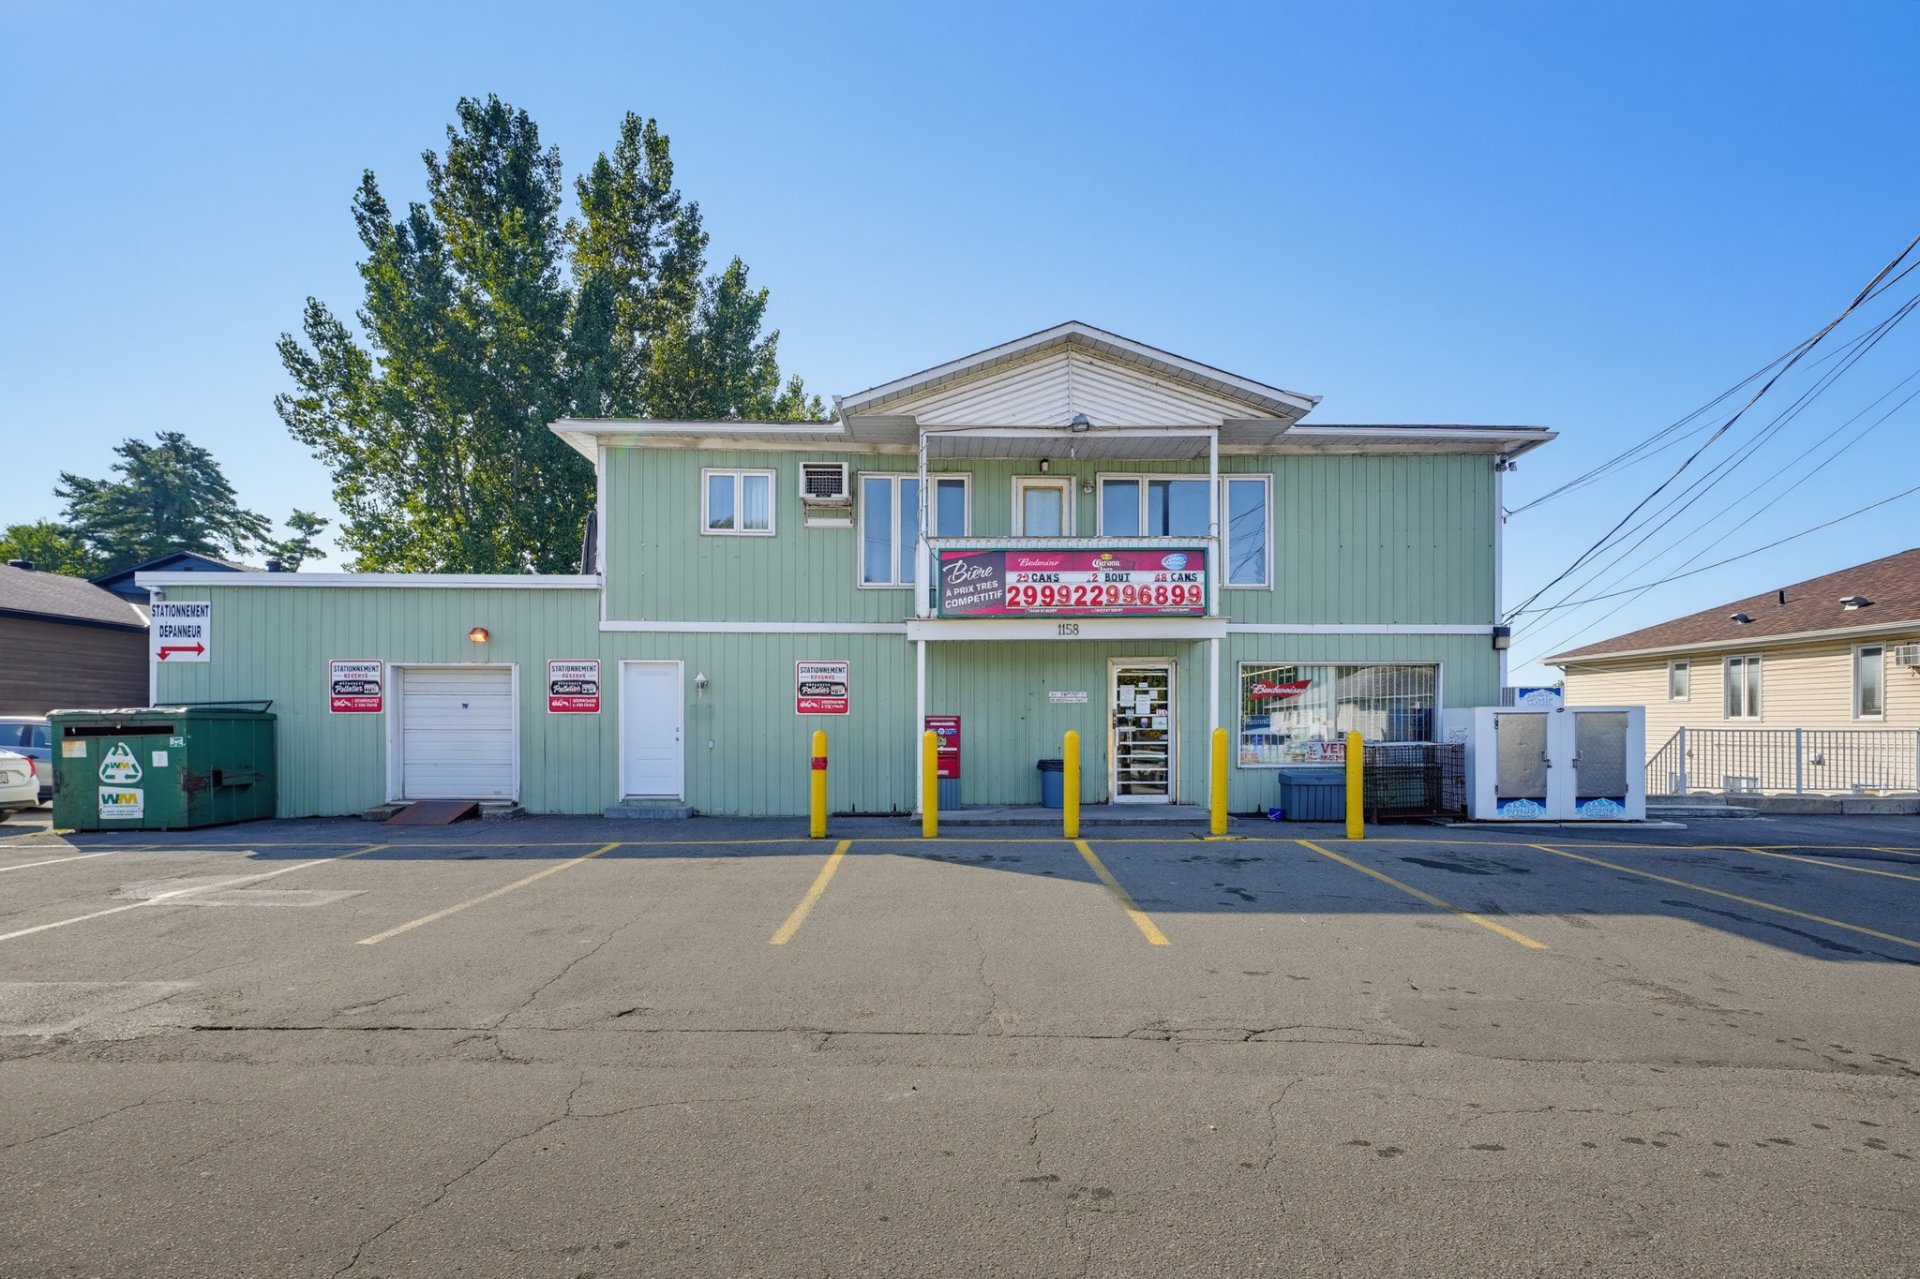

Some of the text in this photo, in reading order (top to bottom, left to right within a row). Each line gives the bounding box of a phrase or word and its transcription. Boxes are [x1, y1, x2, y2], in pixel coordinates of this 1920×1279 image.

[1018, 558, 1059, 567] Budweiser
[1092, 559, 1120, 568] Corona
[943, 560, 993, 584] Bière
[1031, 573, 1060, 582] CANS
[1092, 573, 1130, 582] 2 BOUT
[1171, 573, 1198, 582] CANS
[954, 585, 974, 595] PRIX
[976, 580, 998, 591] TRÈS
[945, 590, 1003, 608] COMPÉTITIF
[152, 604, 209, 617] STATIONNEMENT
[159, 621, 201, 638] DÉPANNEUR
[1057, 623, 1079, 635] 1158
[1251, 684, 1307, 694] Budweiser
[1321, 743, 1347, 755] VER
[101, 794, 138, 805] WM
